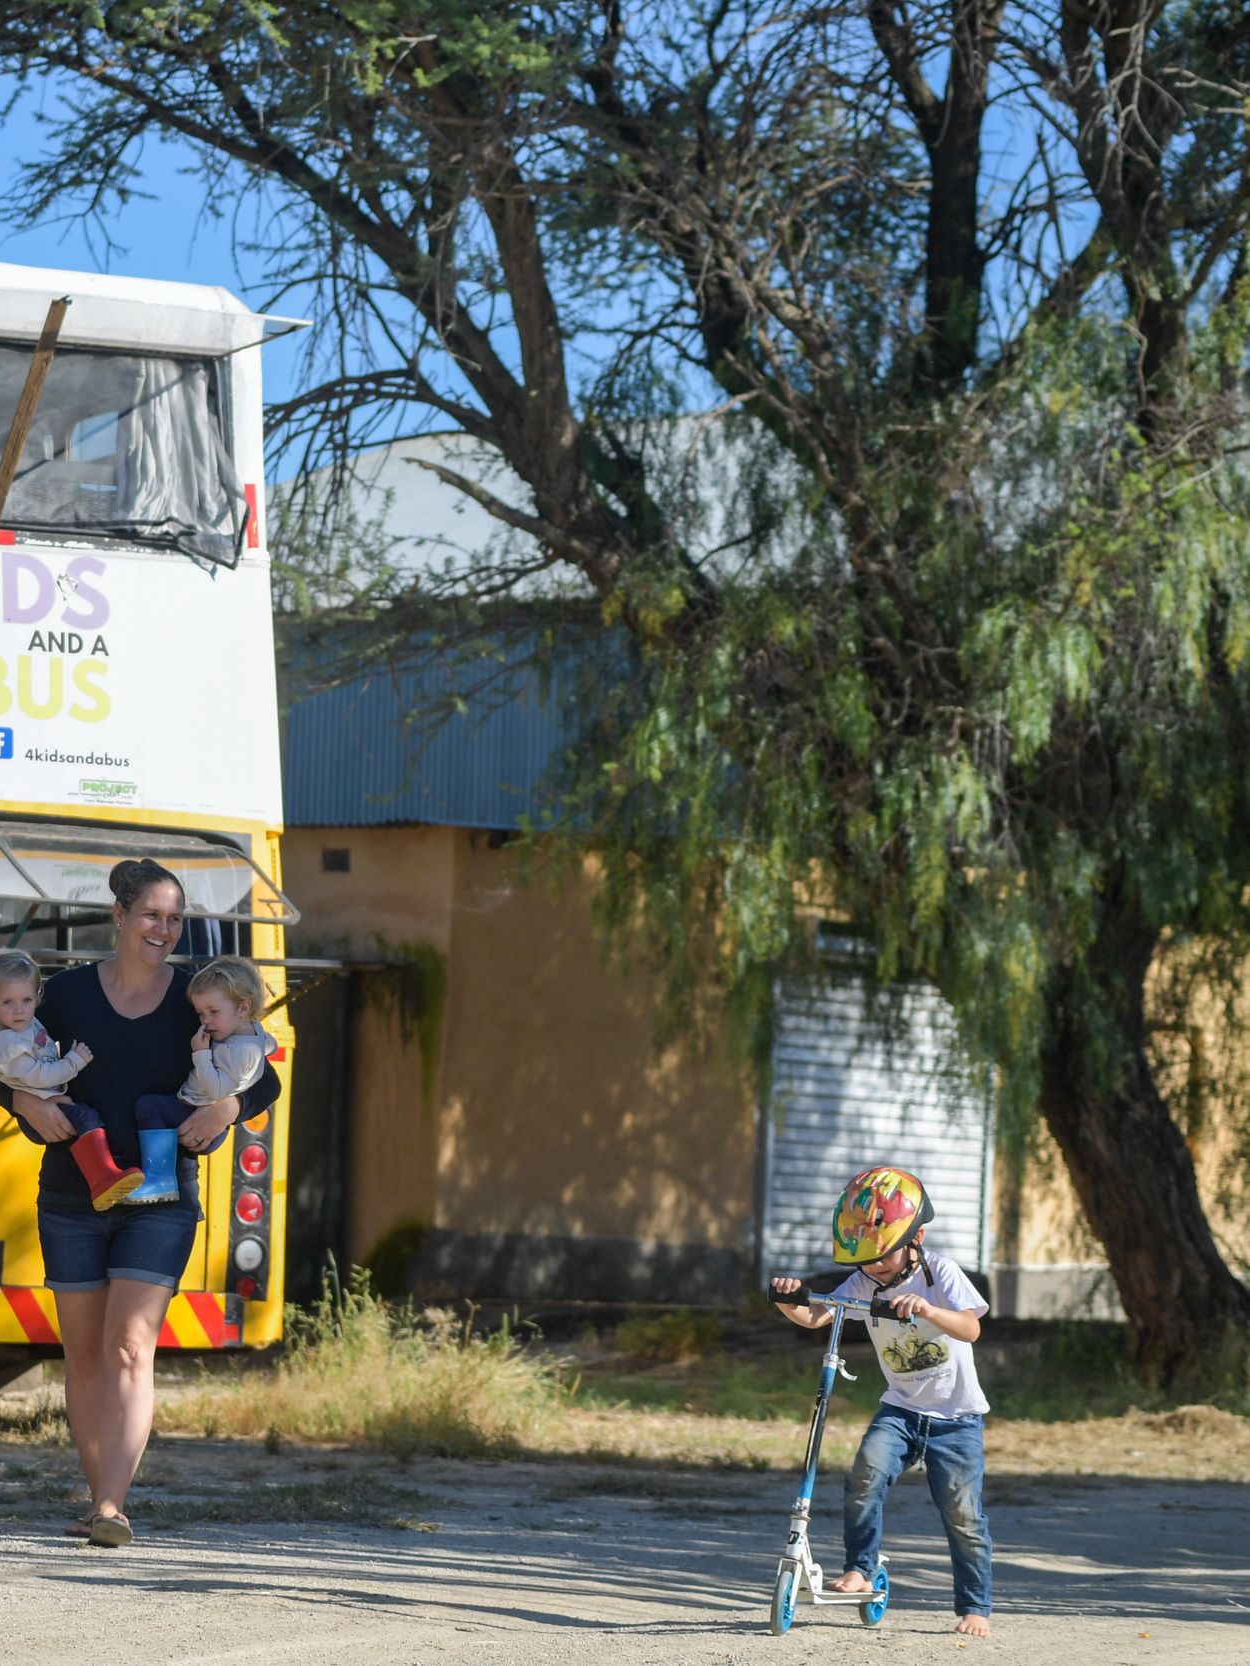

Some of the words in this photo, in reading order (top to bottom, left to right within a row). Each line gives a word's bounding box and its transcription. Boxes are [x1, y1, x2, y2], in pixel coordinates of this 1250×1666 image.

[28, 630, 84, 653] AND
[90, 634, 110, 656] A
[24, 748, 130, 768] 4kidsandabus
